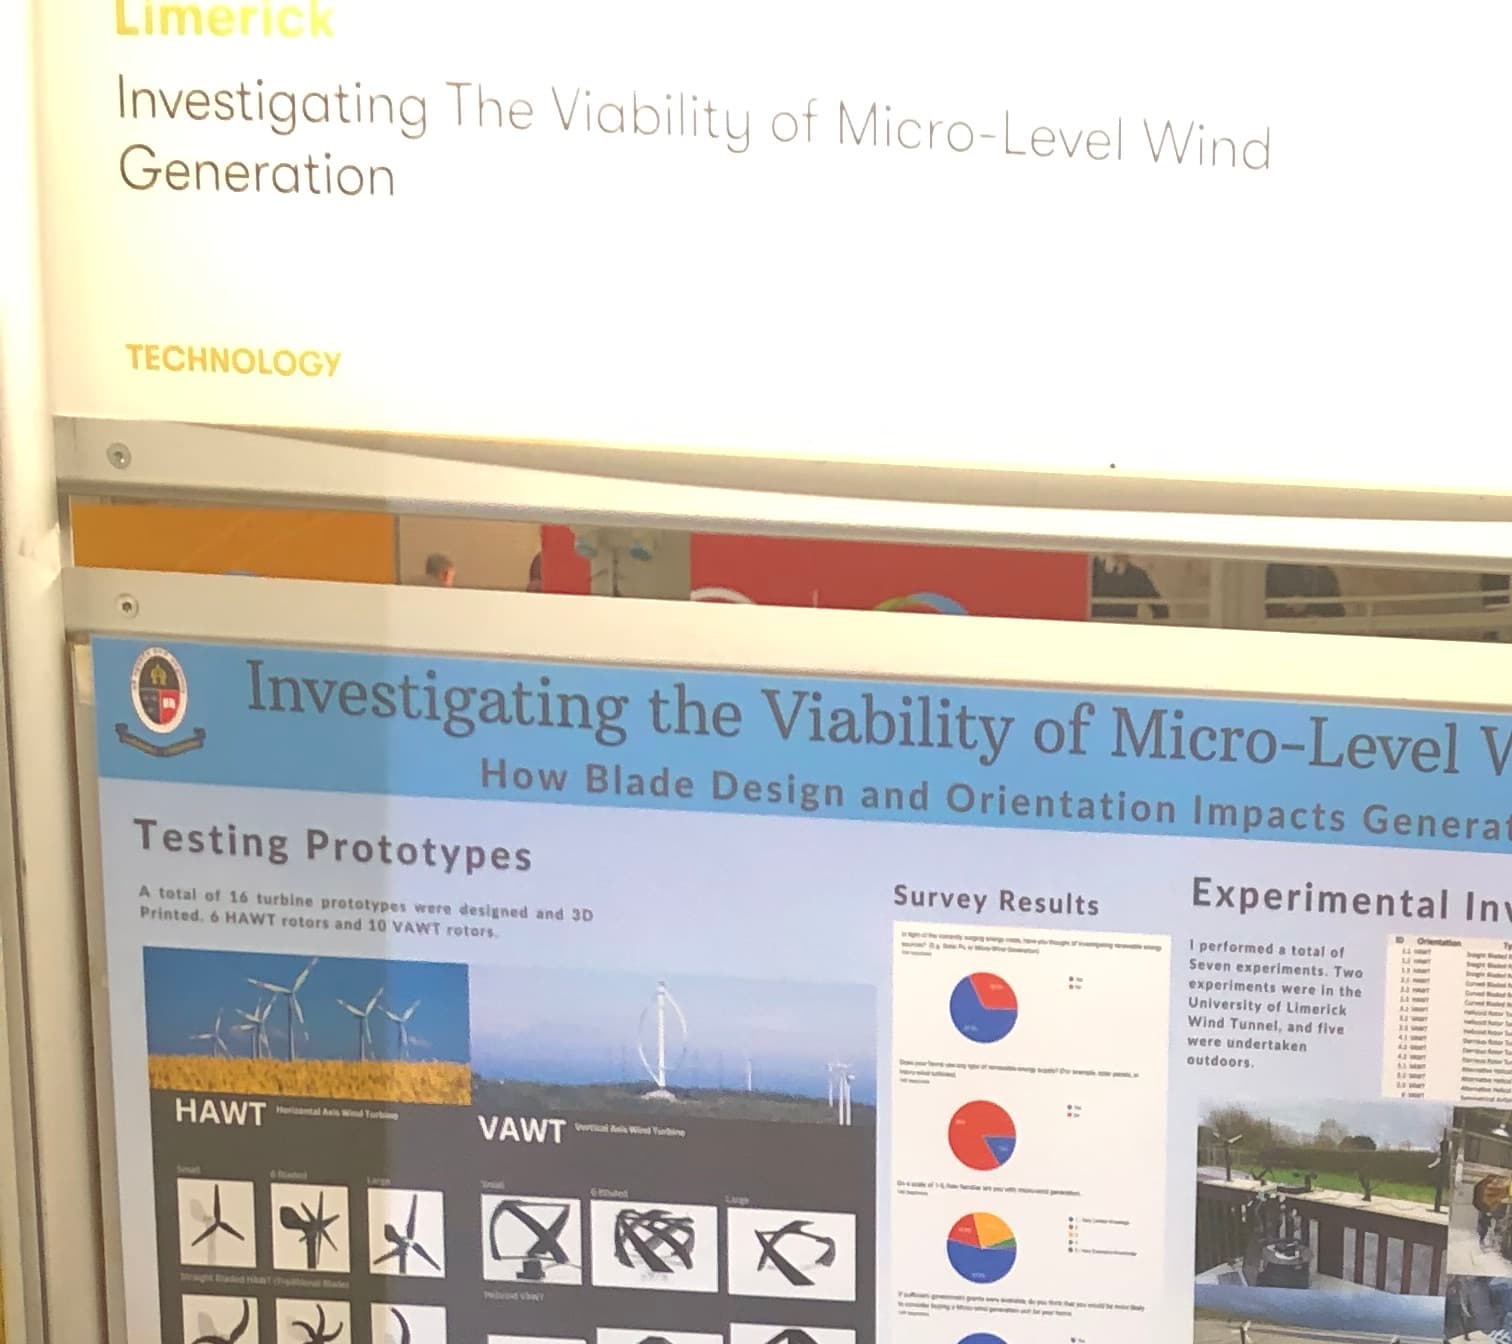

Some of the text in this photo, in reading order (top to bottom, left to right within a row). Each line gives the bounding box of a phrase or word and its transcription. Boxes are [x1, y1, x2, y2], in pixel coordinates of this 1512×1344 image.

[115, 0, 334, 38] Limerick
[118, 73, 1270, 170] Investigating The Viability of Micro-Level Wind
[120, 143, 394, 196] Generation
[124, 342, 343, 379] TECHNOLOGY
[246, 659, 629, 747] Investigating
[649, 682, 742, 738] the
[761, 688, 1015, 767] Viability
[1034, 702, 1095, 755] of
[1112, 705, 1460, 777] Micro-Level
[480, 757, 567, 791] How
[586, 762, 694, 798] Blade
[712, 769, 844, 813] Design
[861, 780, 929, 811] and
[946, 782, 1176, 824] Orientation
[1194, 794, 1347, 834] Impacts
[133, 817, 532, 875] Testing Prototypes
[139, 885, 594, 922] A total of 16 turbine prototypes were designed and 3D
[894, 884, 1099, 916] Survey Results
[1192, 875, 1449, 920] Experimental
[210, 909, 220, 923] 6
[226, 911, 275, 926] HAWT
[281, 914, 329, 930] rotors
[335, 917, 362, 932] and
[368, 918, 386, 932] 10
[392, 920, 442, 936] VAWT
[1189, 939, 1345, 960] I performed a total of
[1189, 957, 1364, 979] Seven experiments. Two
[1188, 978, 1363, 997] experiments were in the
[1188, 996, 1347, 1017] University of Limerick
[1187, 1016, 1345, 1035] Wind Tunnel, and five
[1187, 1035, 1308, 1053] were undertaken
[1186, 1053, 1255, 1070] outdoors.
[175, 1097, 267, 1126] HAWT
[478, 1115, 567, 1144] VAWT
